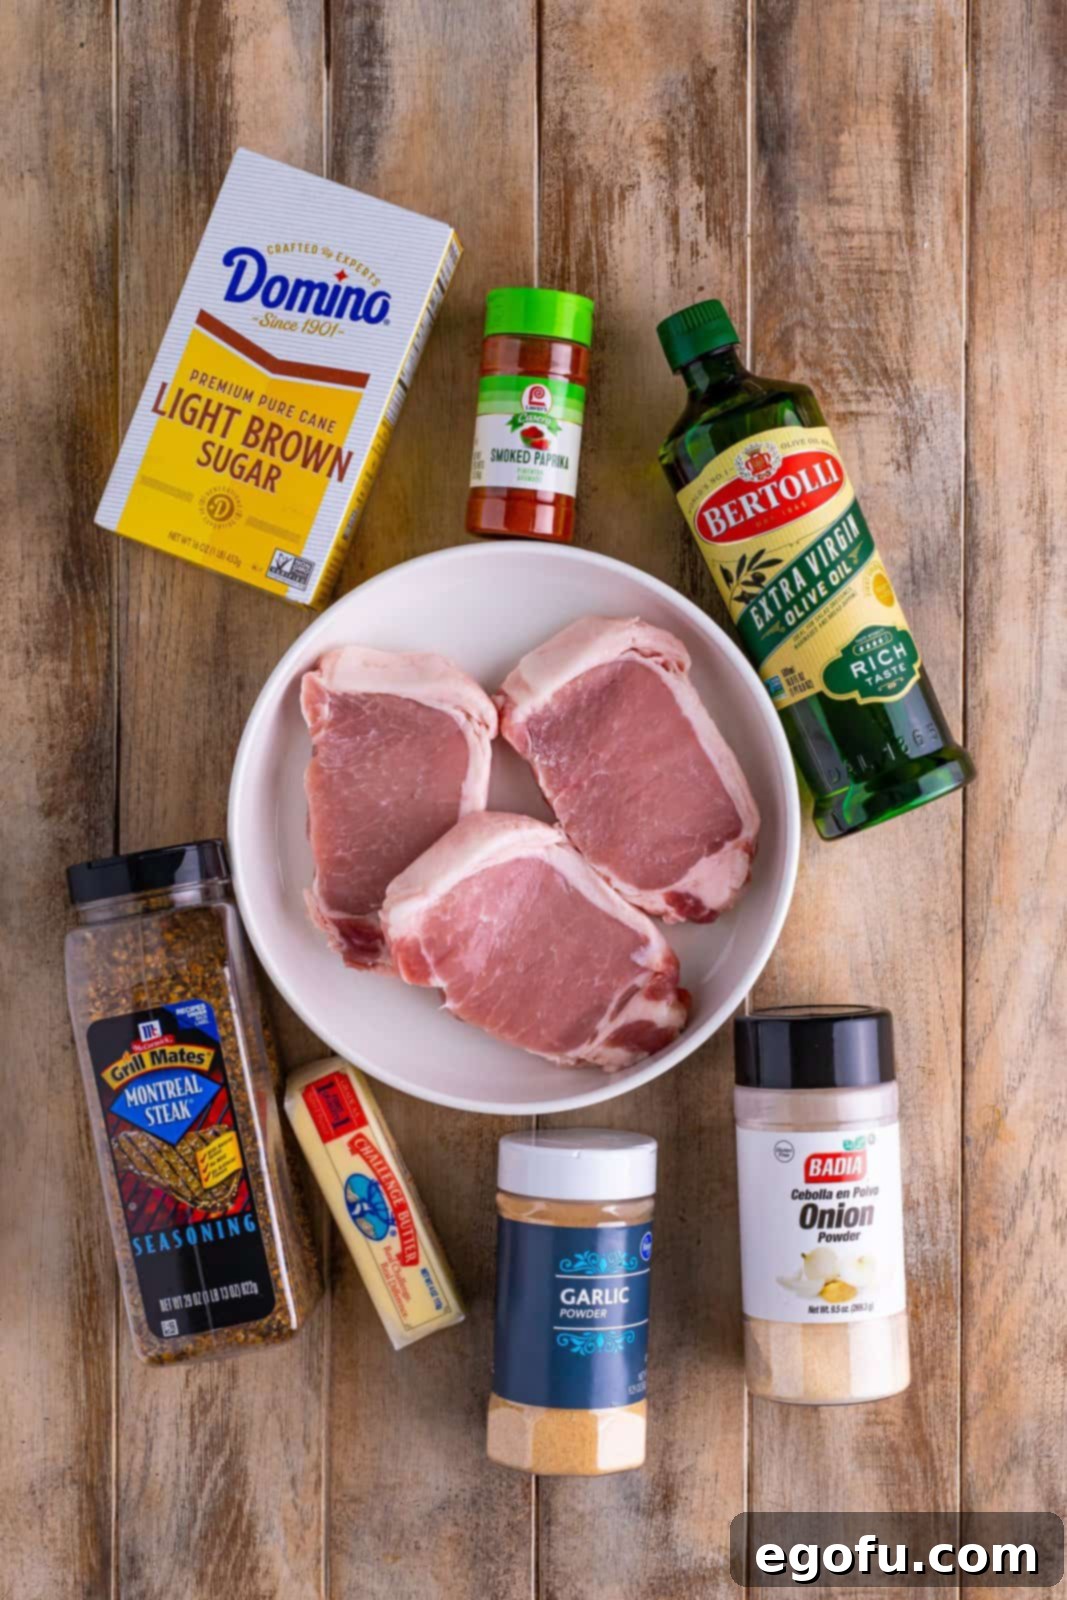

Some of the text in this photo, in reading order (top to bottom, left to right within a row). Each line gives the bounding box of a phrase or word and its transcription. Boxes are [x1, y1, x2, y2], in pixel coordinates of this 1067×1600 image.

[267, 242, 318, 255] CRAFTED
[335, 252, 381, 287] EXPERTS
[222, 246, 392, 325] Domino
[189, 368, 337, 434] PREMIUM PURE CANE
[151, 381, 354, 483] LIGHT BROWN
[196, 440, 282, 493] SUGAR
[490, 447, 531, 465] SMOKED
[534, 451, 570, 470] PAPRIKA
[703, 459, 840, 537] BERTOLLI
[750, 566, 807, 631] EXTRA
[805, 513, 860, 576] VIRGIN
[784, 581, 828, 626] OLIVE
[828, 560, 853, 586] OIL
[850, 642, 907, 678] RICH
[865, 663, 906, 686] TASTE
[176, 1003, 207, 1015] RECIPES
[110, 1048, 205, 1082] Grill Mates
[124, 1074, 203, 1108] MONTREAL
[145, 1101, 192, 1127] STEAK
[809, 1156, 863, 1177] BADIA
[353, 1135, 418, 1264] CHALLENGE BUTTER
[791, 1185, 879, 1201] Cebolla en Polvo
[799, 1202, 875, 1230] Onion
[132, 1213, 257, 1256] SEASONING
[817, 1230, 861, 1244] Powder
[159, 1297, 173, 1312] NET
[560, 1286, 630, 1306] GARLIC
[559, 1308, 608, 1319] POWDER
